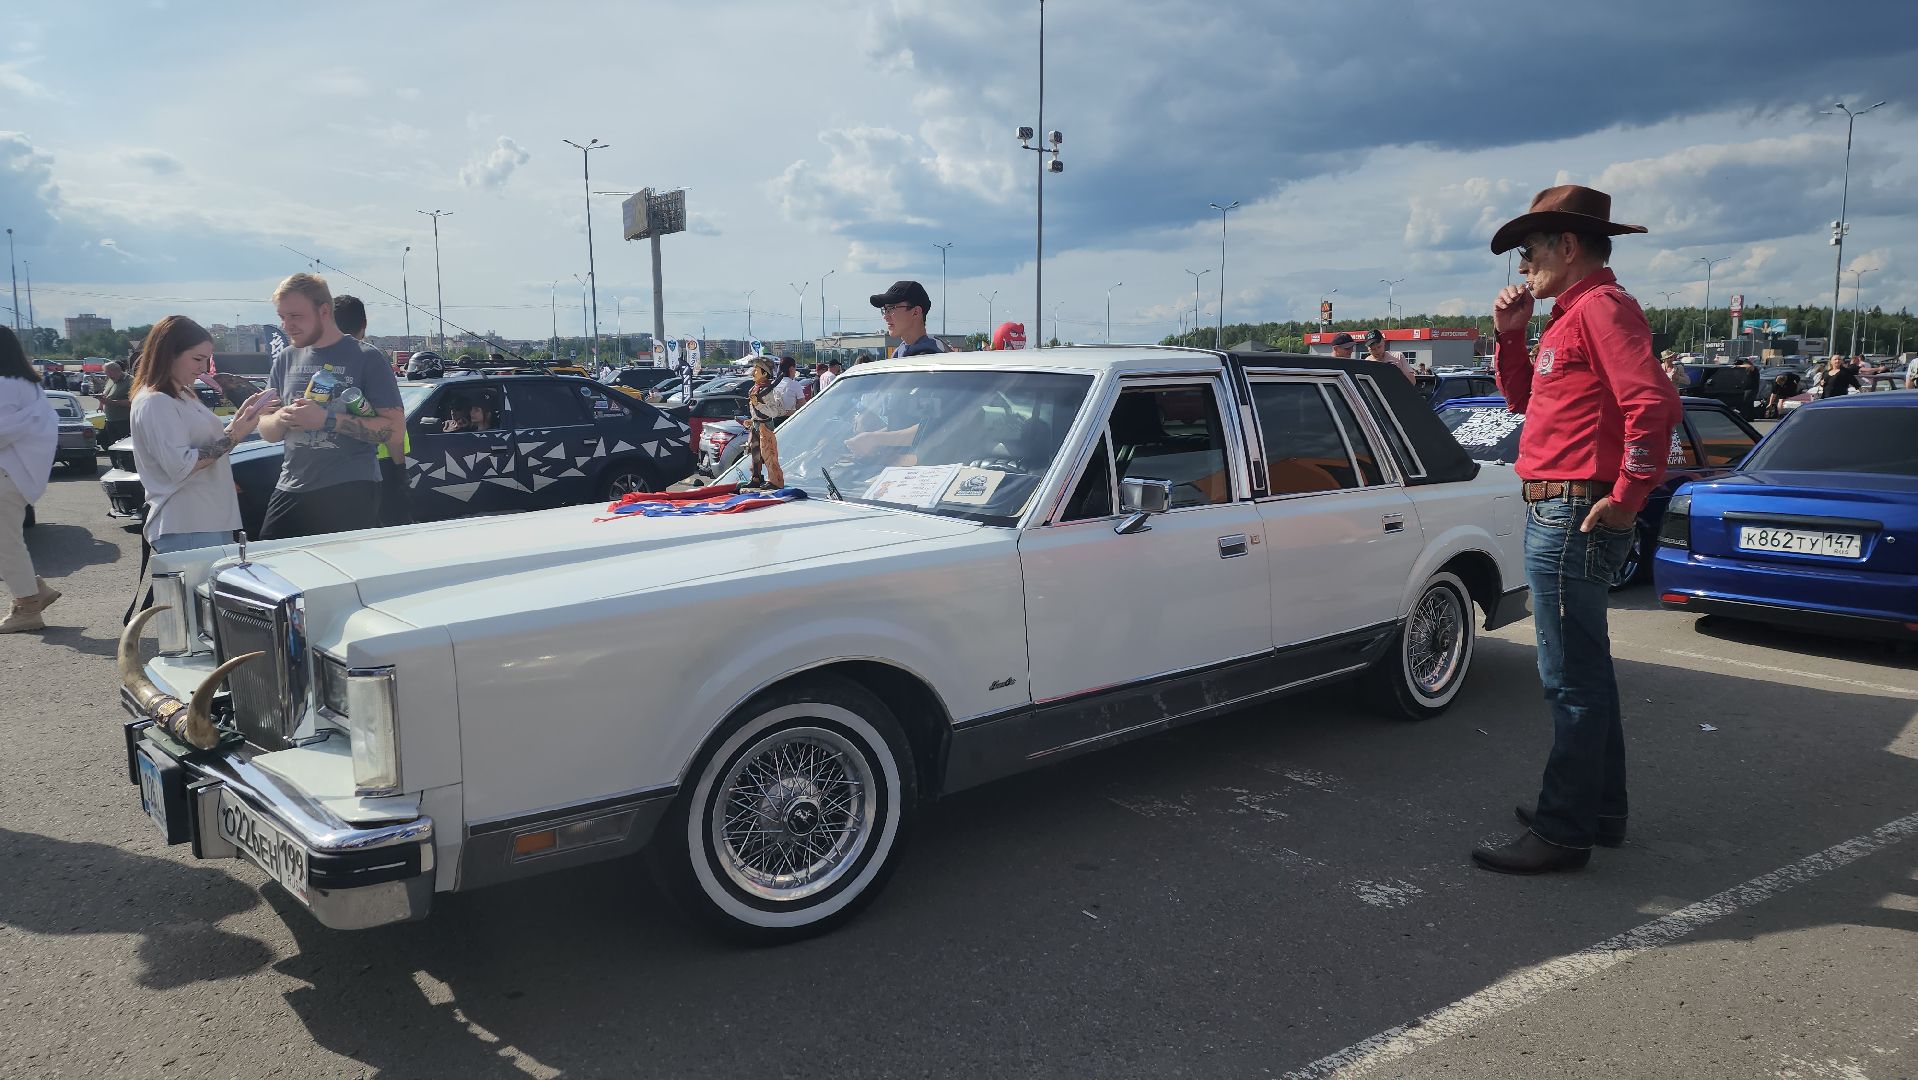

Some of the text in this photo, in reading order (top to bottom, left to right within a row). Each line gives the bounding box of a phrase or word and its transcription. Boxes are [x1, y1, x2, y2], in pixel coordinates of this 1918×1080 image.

[1746, 530, 1855, 550] К862ТУ 147
[280, 839, 305, 881] 199
